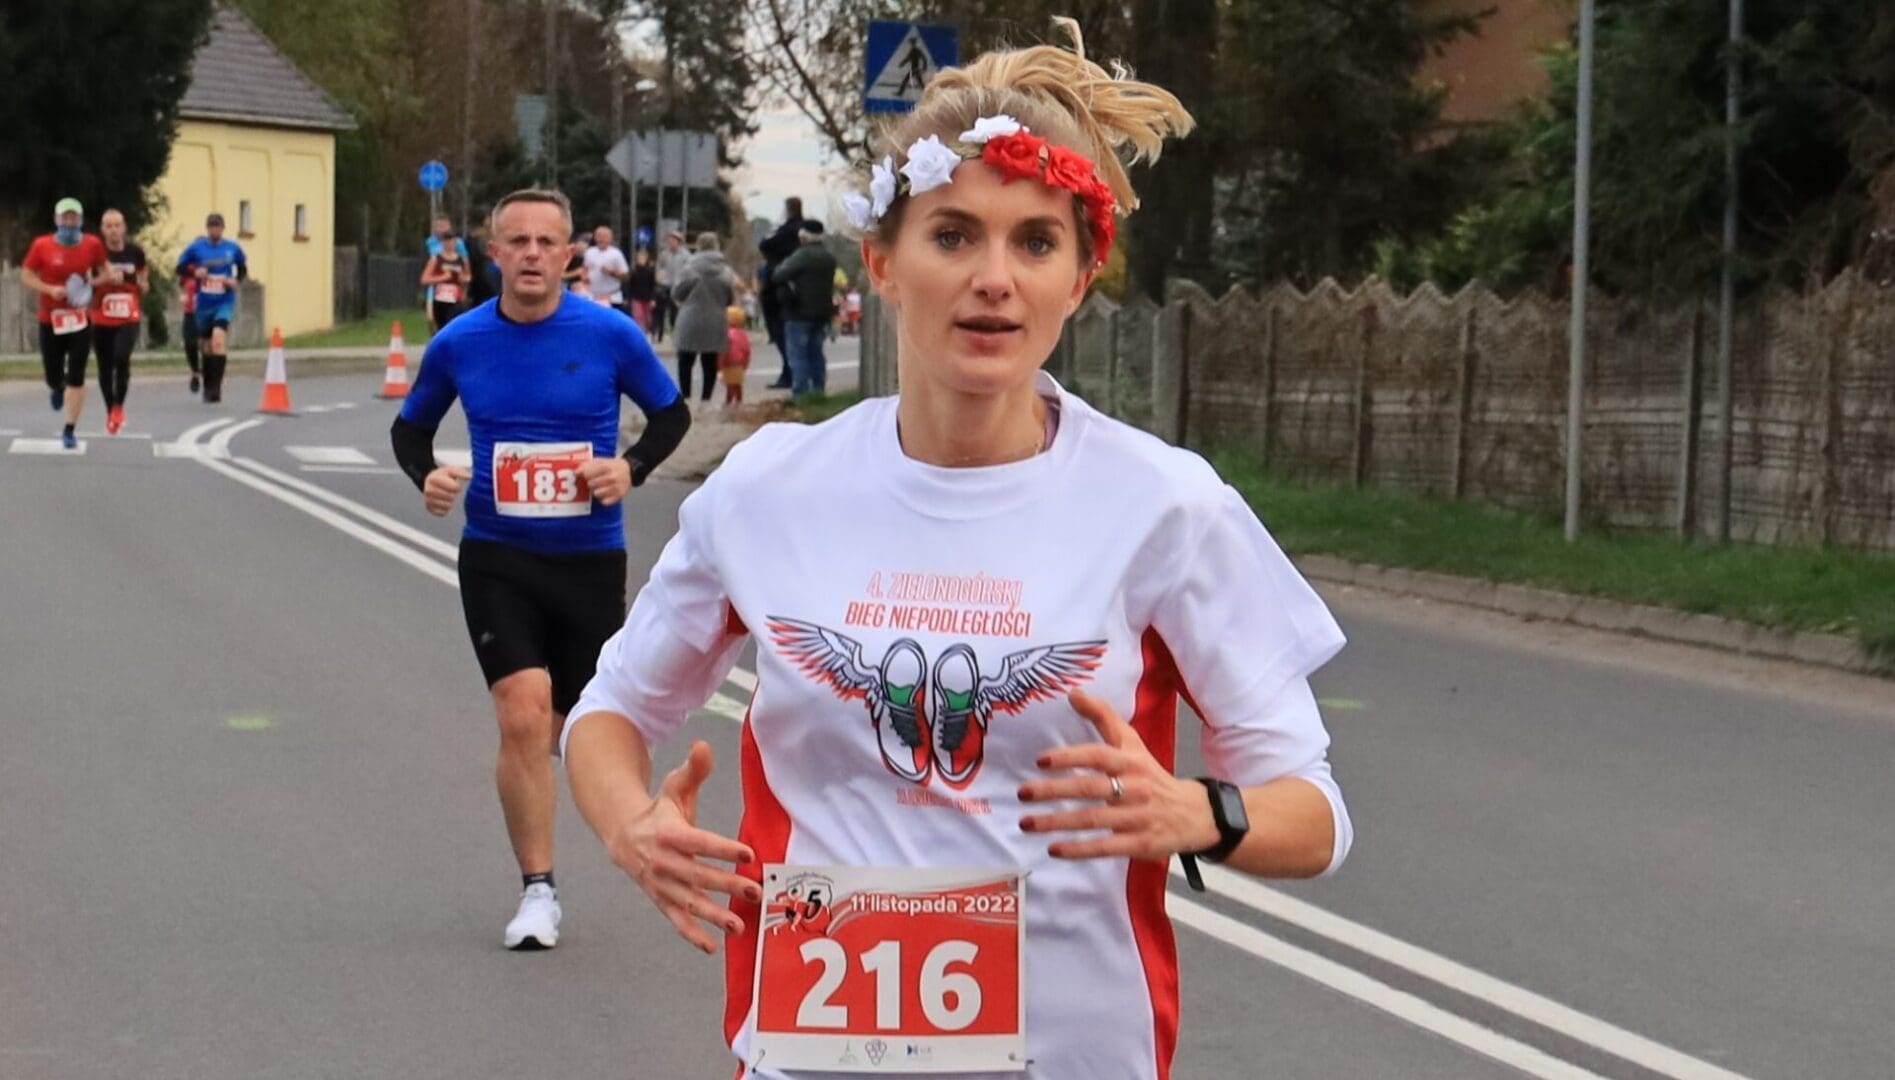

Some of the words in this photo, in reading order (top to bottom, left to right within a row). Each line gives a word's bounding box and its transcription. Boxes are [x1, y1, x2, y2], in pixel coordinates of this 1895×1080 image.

[512, 468, 577, 502] 183
[845, 602, 886, 627] BIEG
[889, 605, 1031, 637] NIEPODLEGŁOŚCI
[803, 889, 822, 919] 5
[871, 895, 957, 916] listopada
[963, 895, 1016, 913] 2022
[796, 937, 982, 1031] 216
